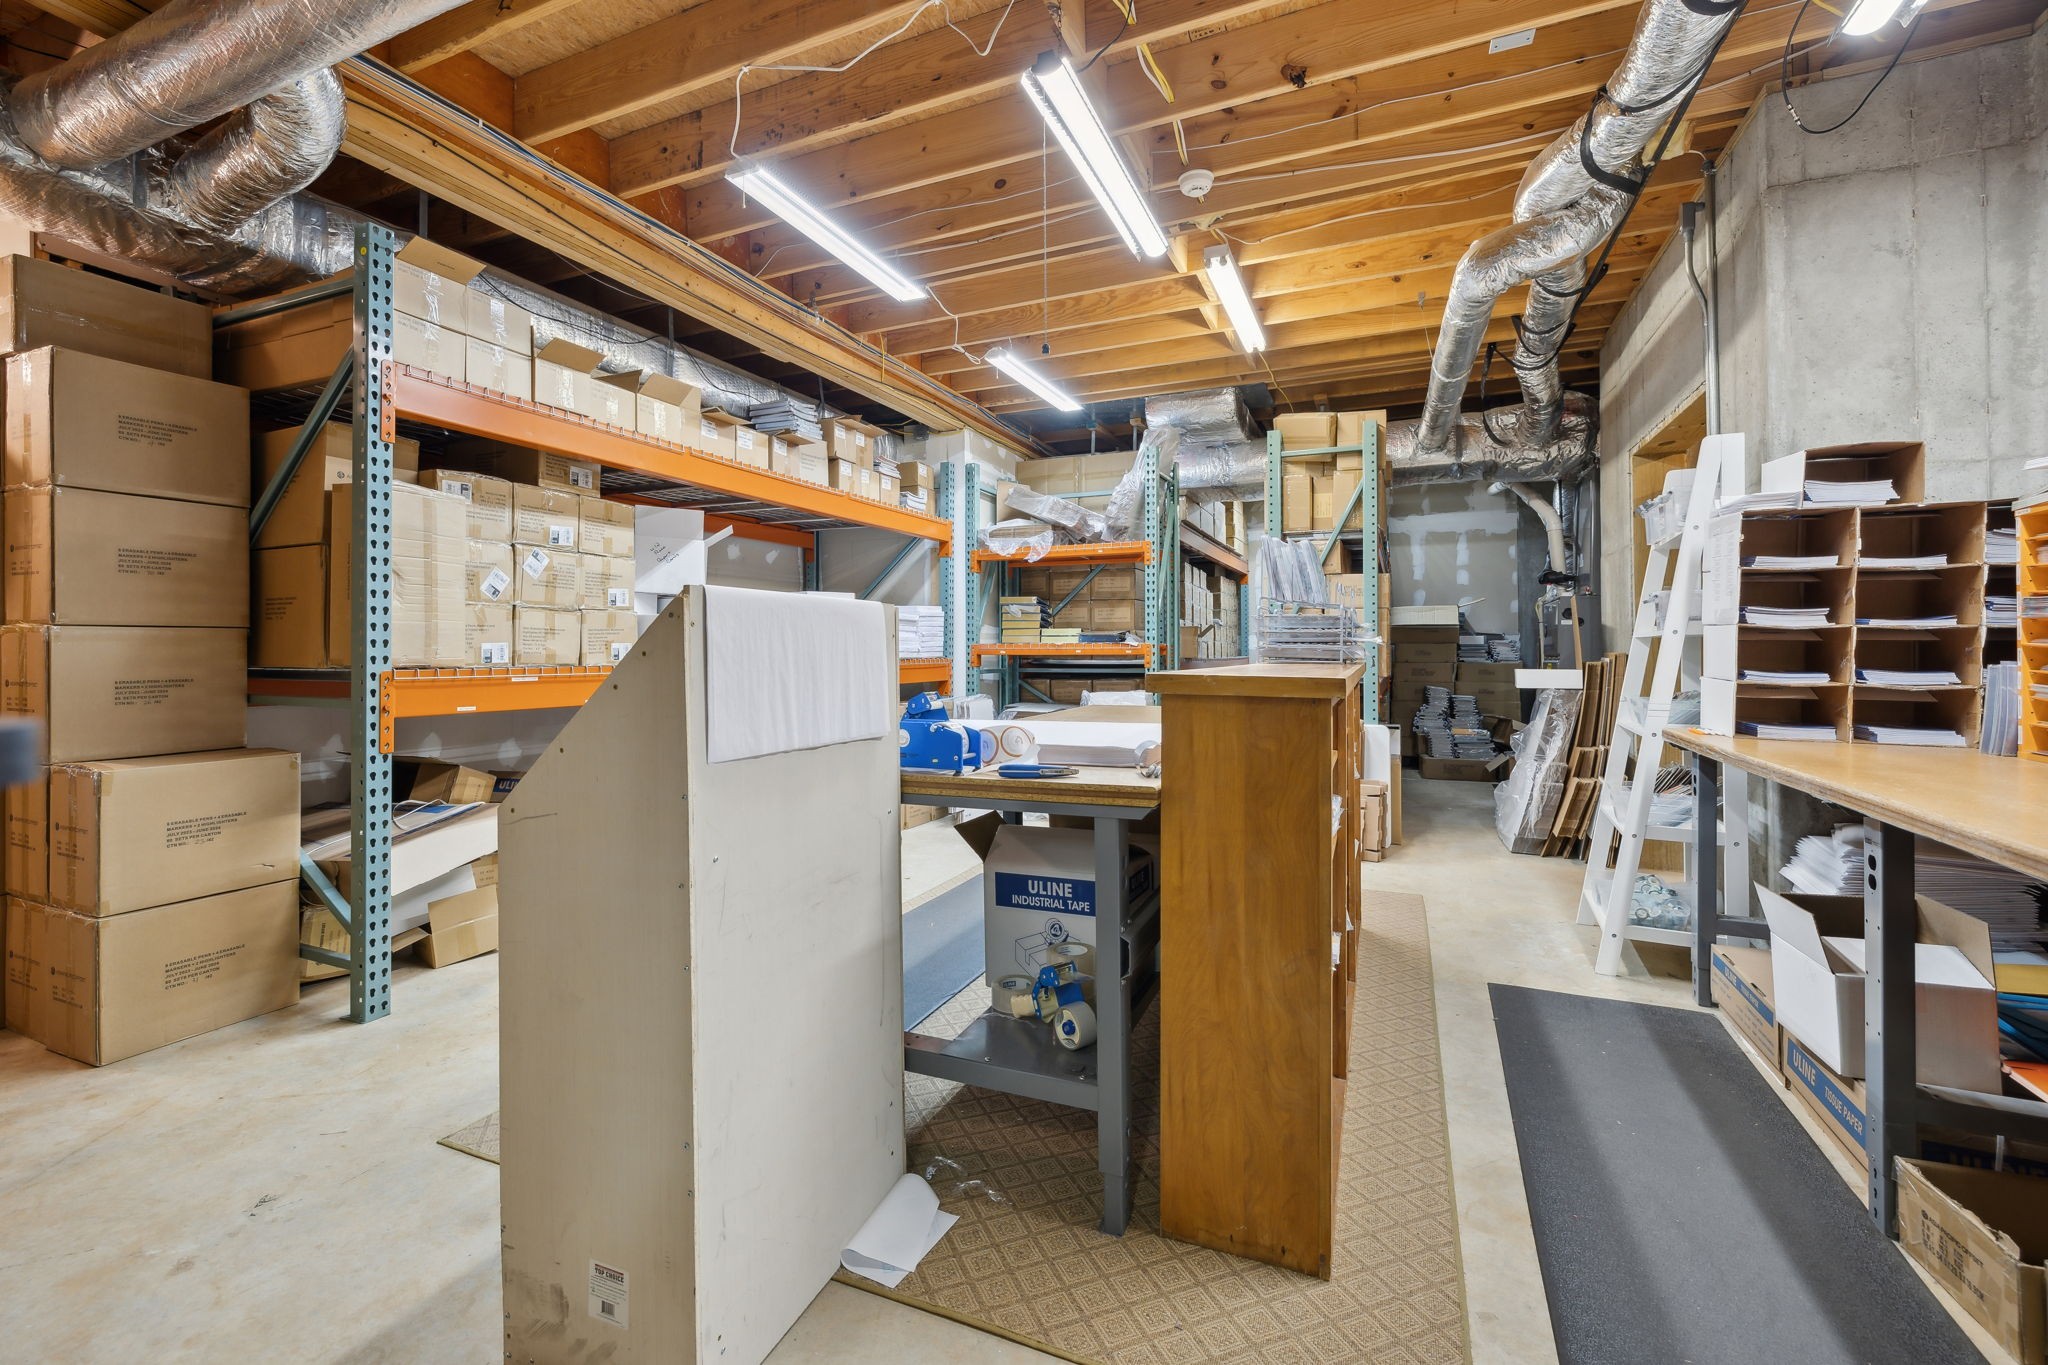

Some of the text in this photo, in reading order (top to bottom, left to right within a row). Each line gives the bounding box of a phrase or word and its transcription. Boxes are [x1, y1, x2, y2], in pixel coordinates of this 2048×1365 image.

[166, 824, 193, 832] MARKERS
[200, 818, 238, 827] HIGHLIGHTERS
[170, 818, 198, 826] ERASABLE
[221, 811, 247, 819] ERASABLE
[1028, 879, 1073, 898] ULINE
[1012, 894, 1090, 912] INDUSTRIAL TAPE
[165, 963, 191, 973] MARKERS
[199, 951, 236, 964] HIGHLIGHTERS
[169, 956, 197, 967] ERASABLE
[219, 944, 245, 954] ERASABLE
[199, 966, 220, 975] CARTON
[1793, 1049, 1863, 1136] ULINE TISSUE PAPER
[594, 1267, 625, 1284] TOP CHOICE
